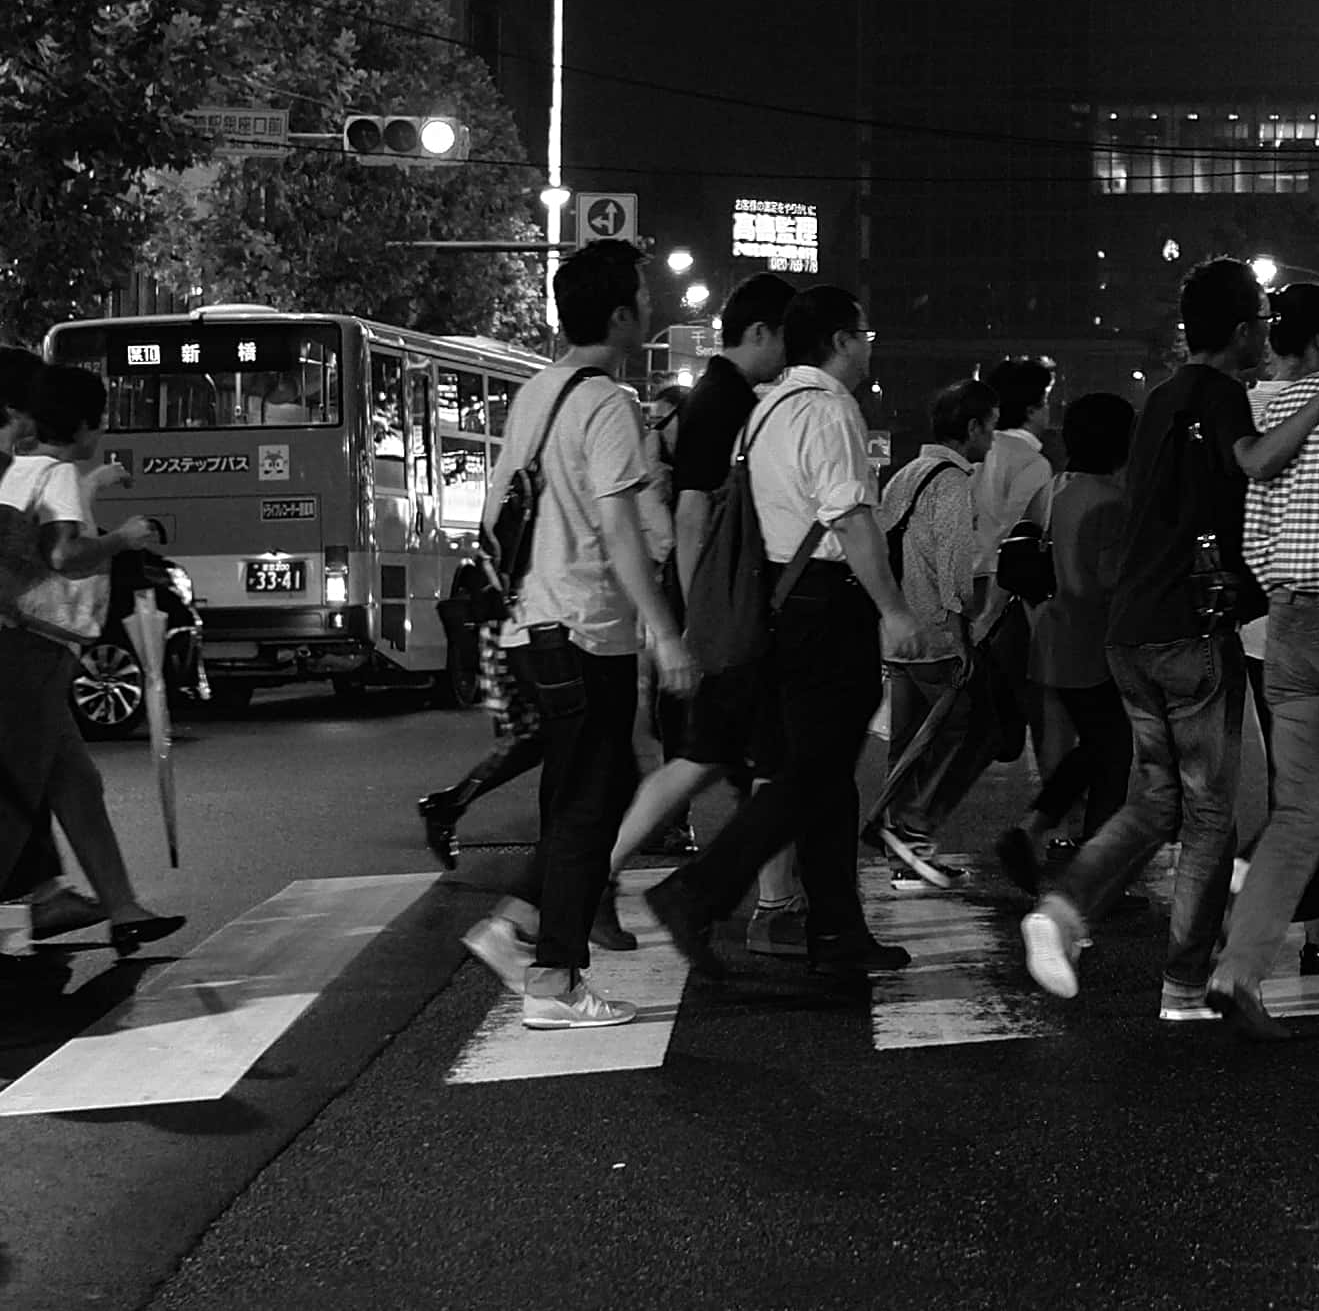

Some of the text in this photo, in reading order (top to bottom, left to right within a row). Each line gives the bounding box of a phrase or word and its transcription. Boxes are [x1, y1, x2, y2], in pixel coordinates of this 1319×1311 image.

[143, 456, 249, 474] ノンステップバス
